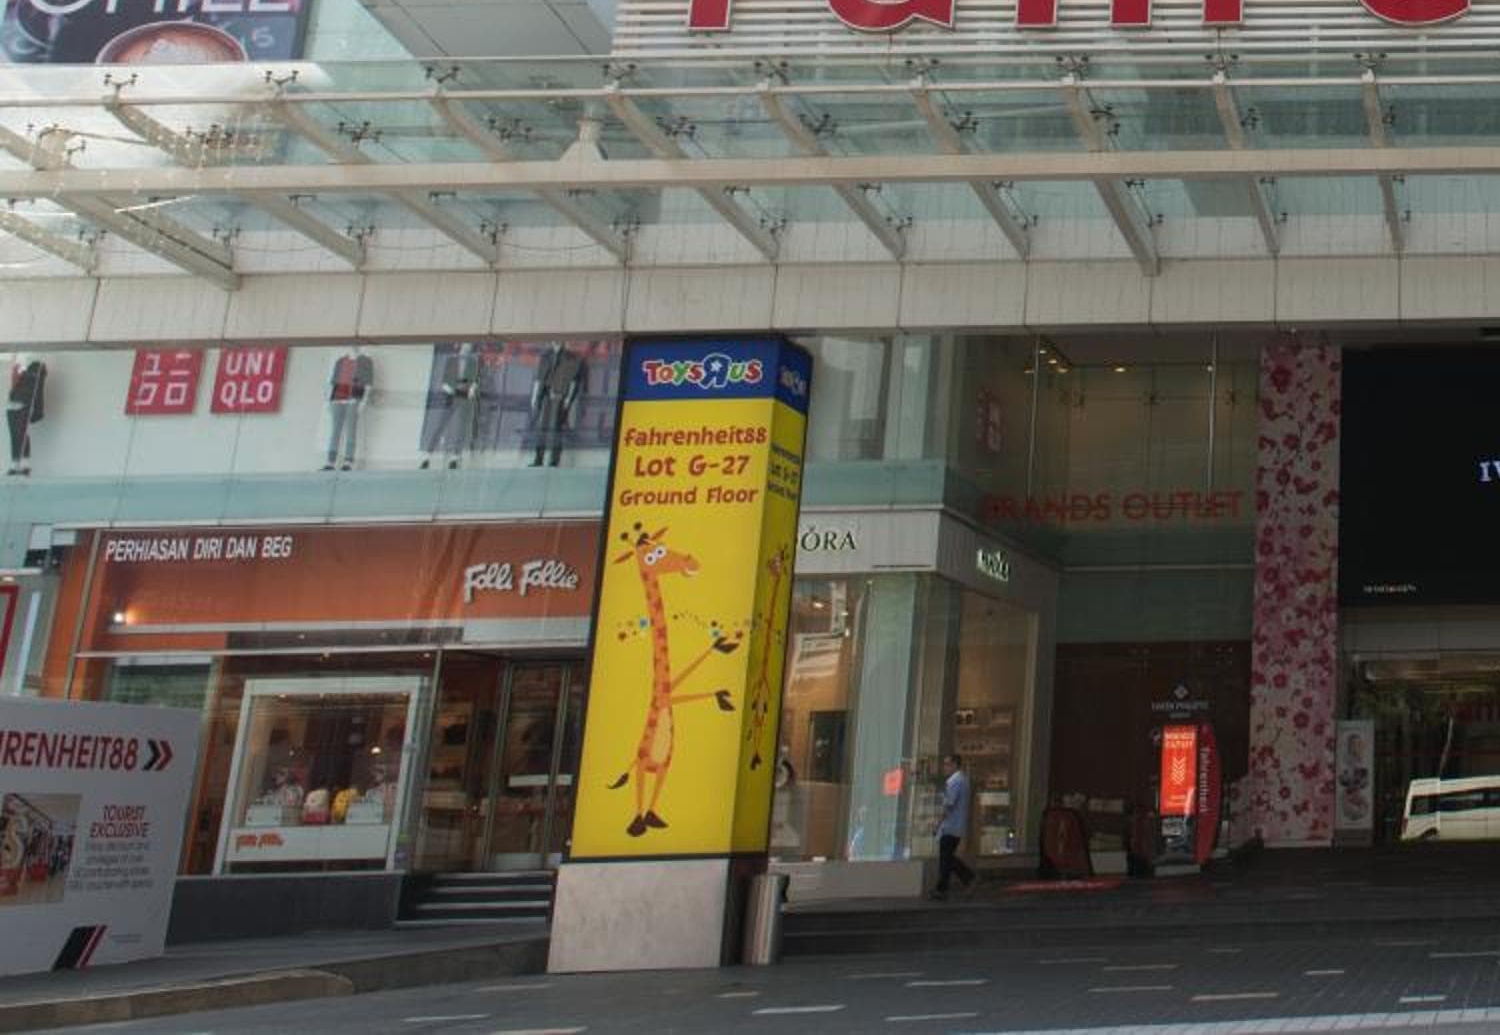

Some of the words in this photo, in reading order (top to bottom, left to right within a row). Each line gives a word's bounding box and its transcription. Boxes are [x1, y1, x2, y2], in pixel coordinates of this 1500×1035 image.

[225, 352, 275, 376] UNI
[220, 380, 274, 408] QLO
[624, 426, 768, 447] fahrenheit88
[634, 455, 676, 477] Lot
[688, 454, 750, 477] G-27
[620, 487, 697, 506] Ground
[706, 486, 759, 504] Floor
[105, 539, 188, 562] PERHIASAN
[194, 538, 222, 560] DIRI
[226, 538, 257, 560] DAN
[262, 536, 293, 559] BEG
[797, 526, 857, 552] ORA
